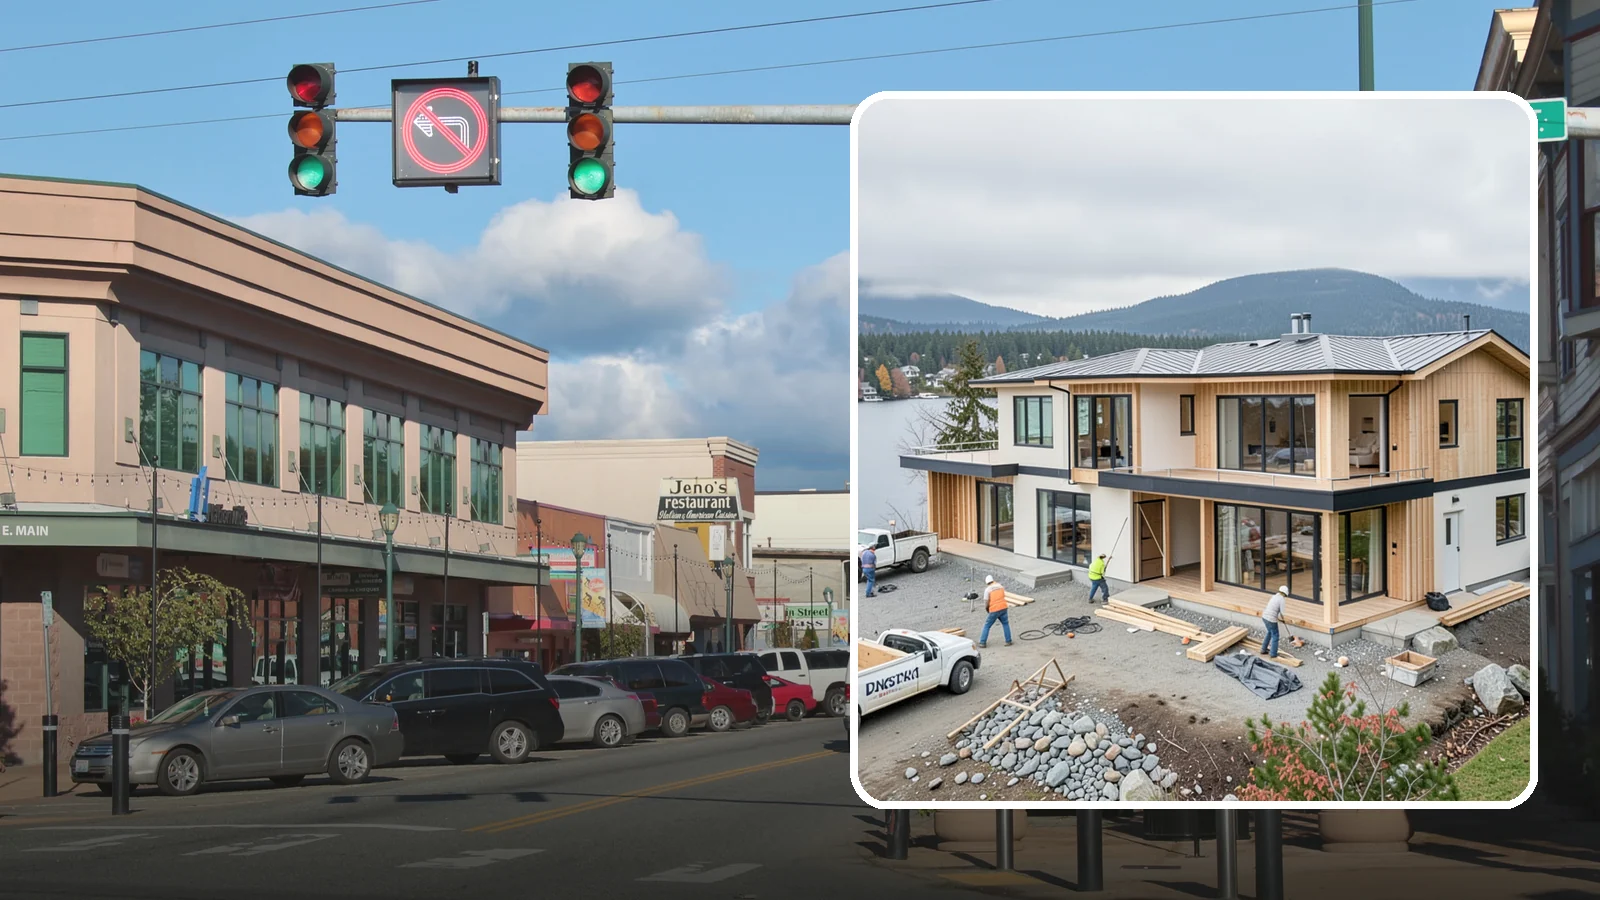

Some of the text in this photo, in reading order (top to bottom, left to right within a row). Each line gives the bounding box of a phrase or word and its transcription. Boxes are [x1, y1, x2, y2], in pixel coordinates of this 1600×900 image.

[669, 480, 728, 494] Jeno's
[665, 496, 731, 509] restaurant
[658, 510, 681, 519] Italian
[686, 510, 715, 519] American
[715, 509, 738, 519] Cuisine
[2, 525, 49, 536] E. MAIN
[797, 607, 829, 617] Street
